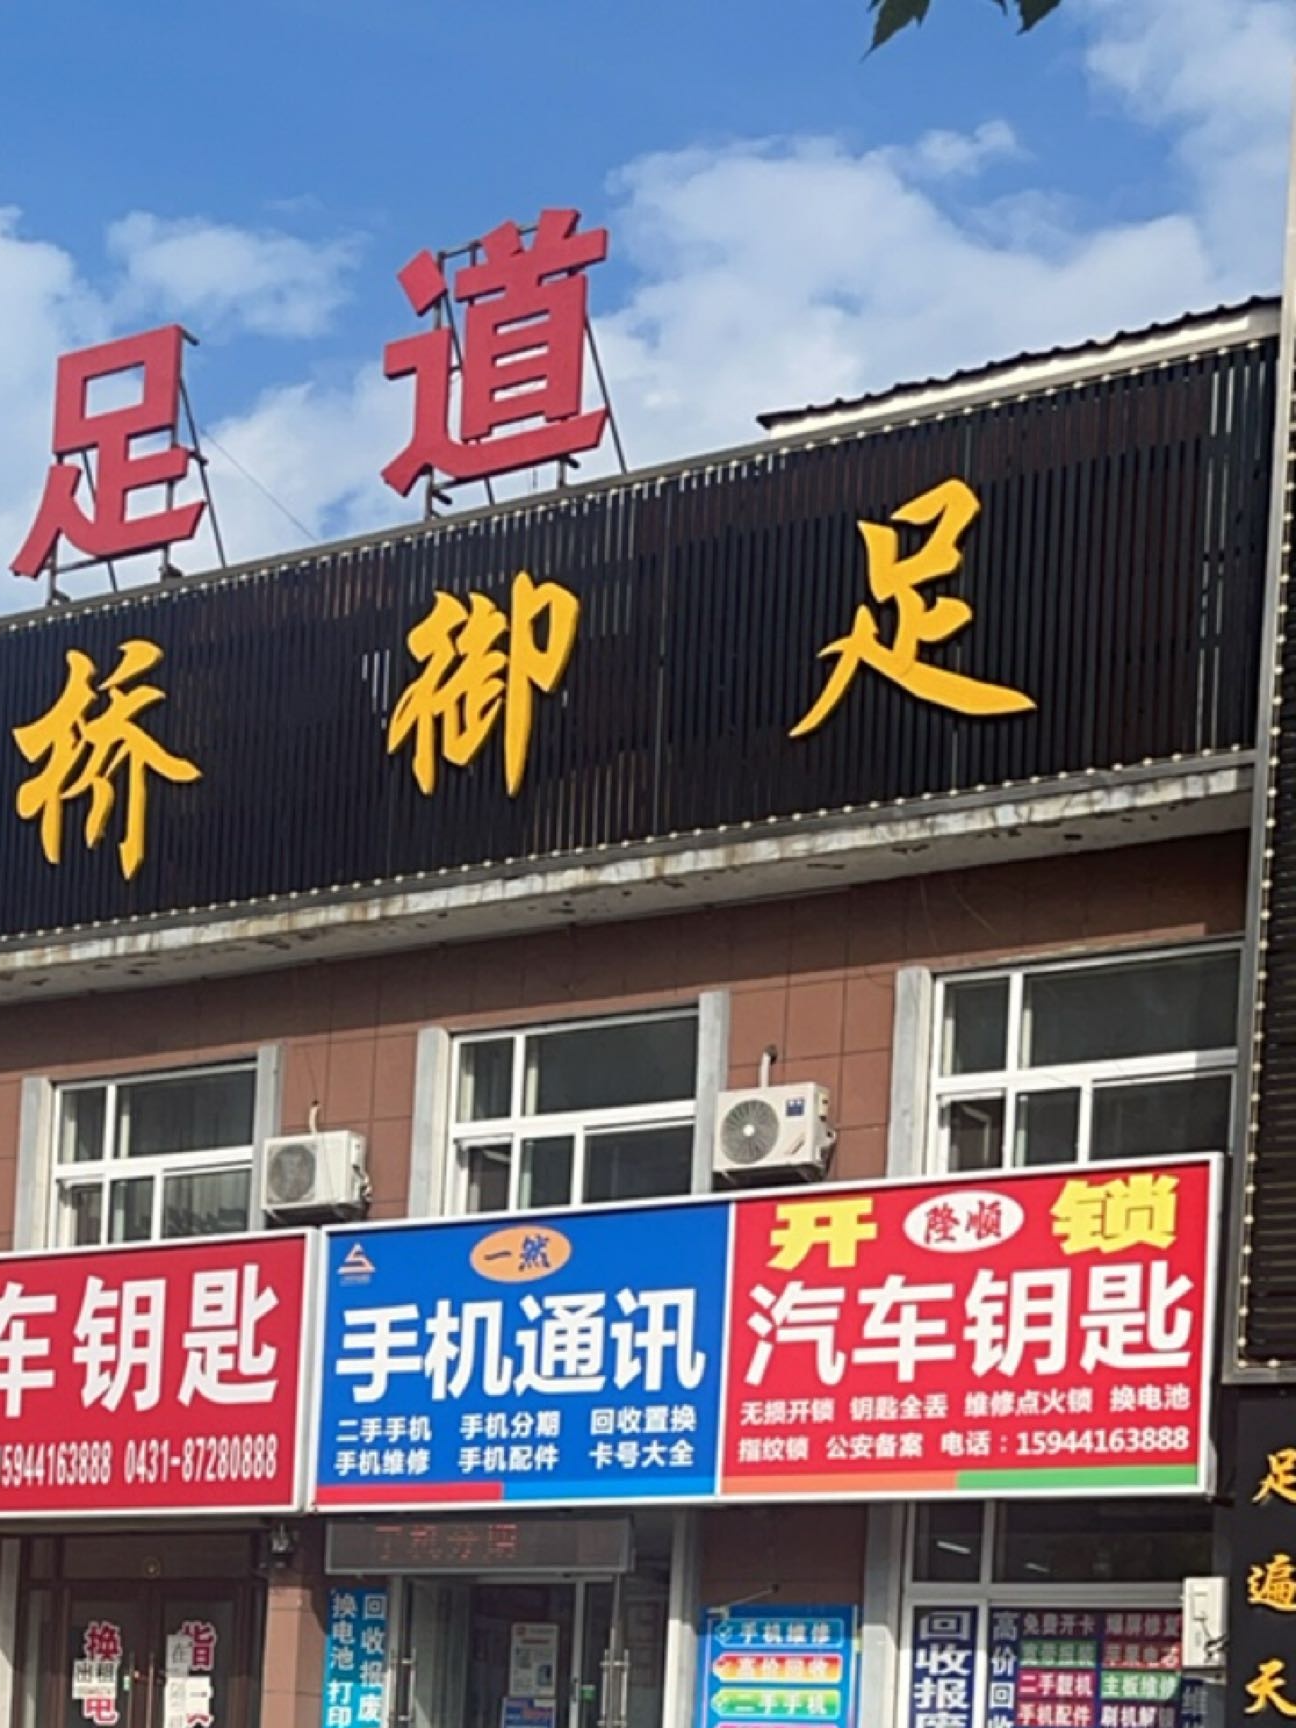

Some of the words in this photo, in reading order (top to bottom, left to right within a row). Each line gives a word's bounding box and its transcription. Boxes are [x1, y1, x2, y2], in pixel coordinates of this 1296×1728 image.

[10, 209, 609, 579] 足道
[923, 1200, 1003, 1245] 隆顺
[335, 1288, 706, 1404] 手机通讯
[744, 1261, 1194, 1387] 汽车钥匙
[336, 1415, 432, 1444] 二手手机
[459, 1410, 562, 1441] 手机分期
[590, 1405, 697, 1435] 回收置换
[740, 1397, 835, 1426] 无损开锁
[850, 1393, 949, 1420] 钥匙全丢
[964, 1386, 1093, 1418] 维修点火锁
[1109, 1382, 1190, 1413] 换电池
[124, 1432, 278, 1484] 0431-87280888
[334, 1447, 431, 1477] 手机维修
[458, 1446, 560, 1474] 手机配件
[589, 1438, 694, 1468] 卡号大全
[738, 1436, 809, 1463] 指纹锁
[826, 1431, 924, 1461] 公安备案
[331, 1593, 358, 1671] 换电池
[1023, 1613, 1096, 1635] 免费开卡
[1018, 1703, 1092, 1726] 手机配件
